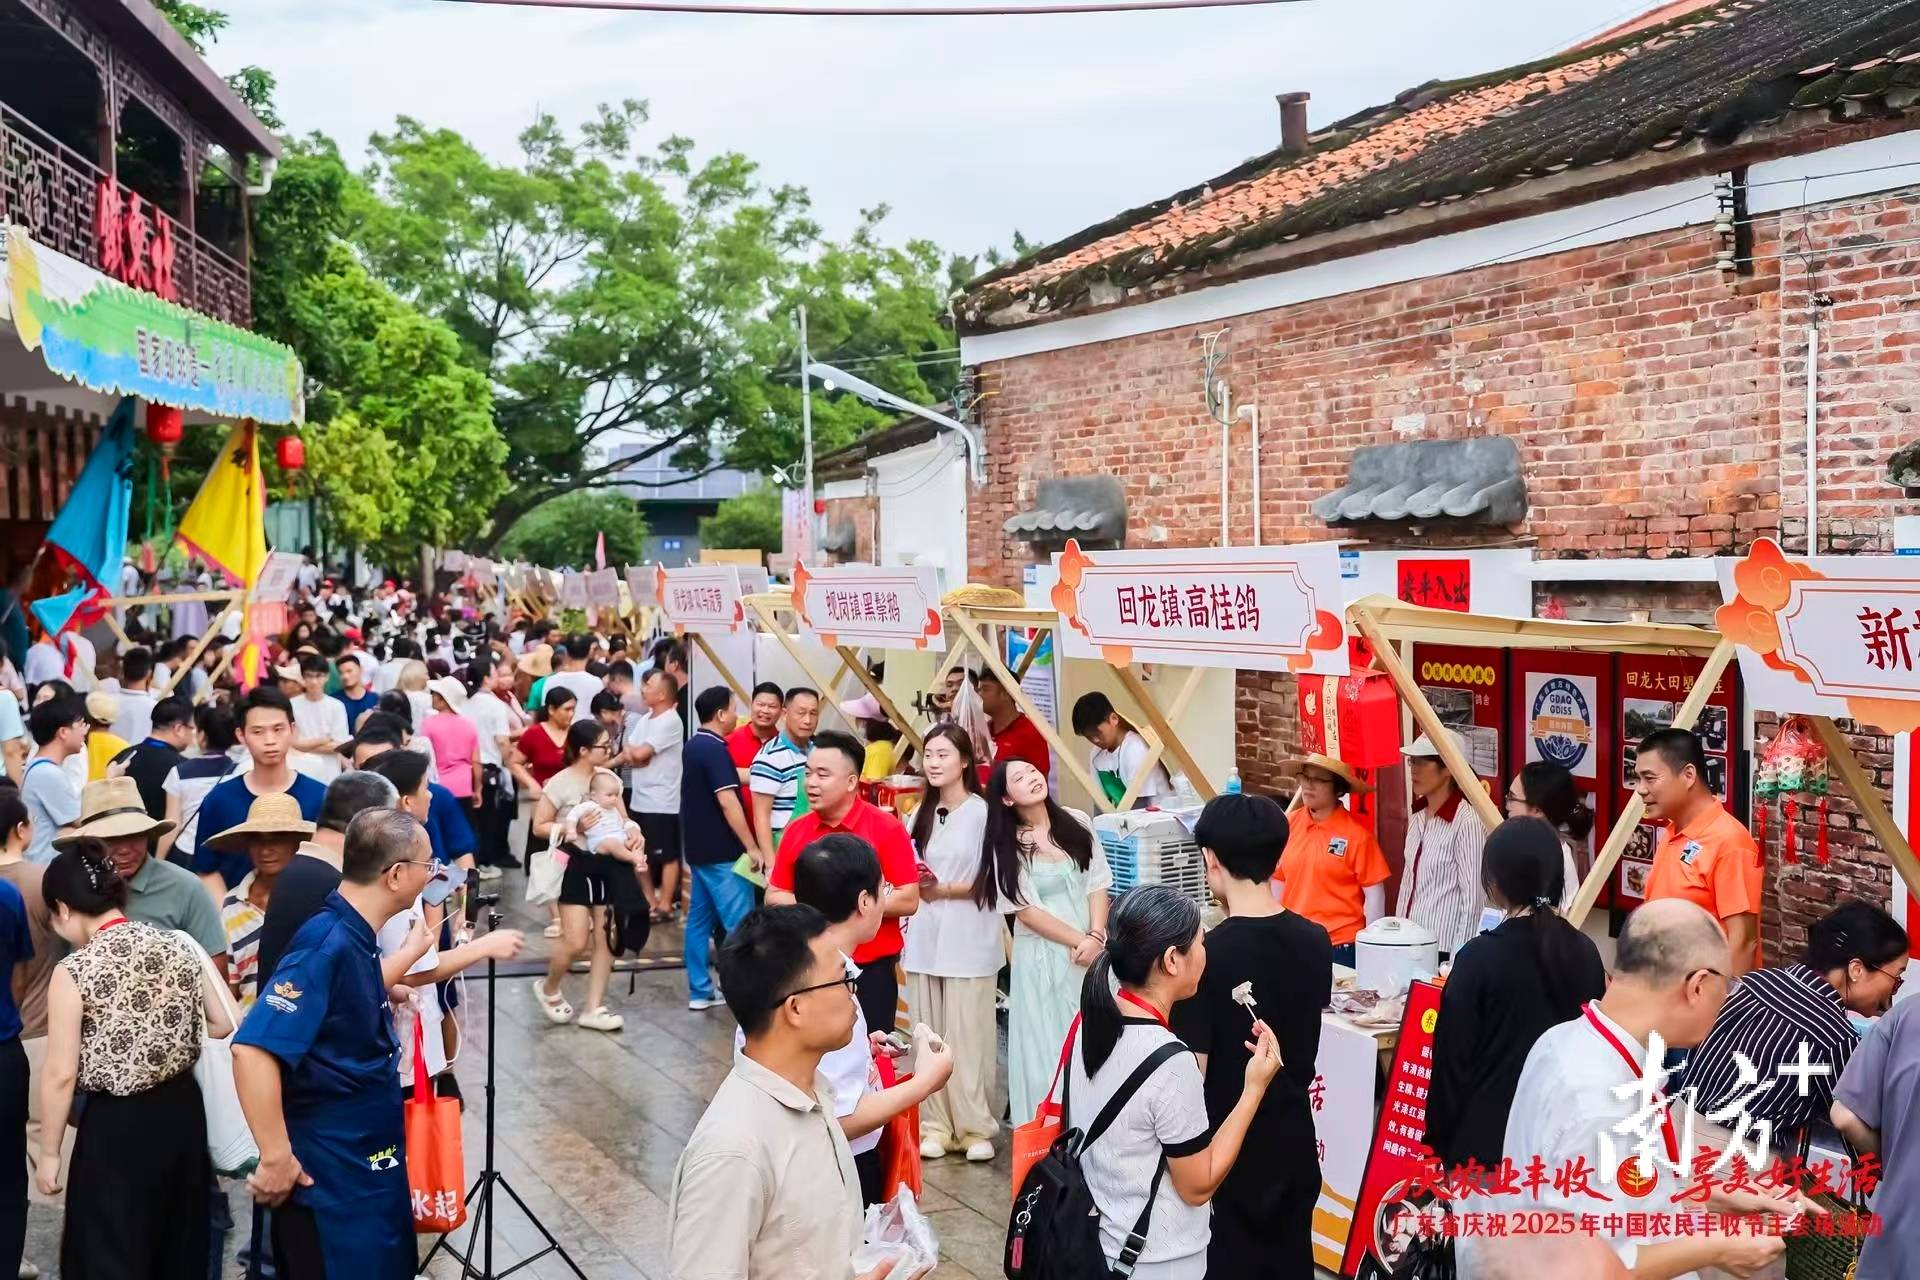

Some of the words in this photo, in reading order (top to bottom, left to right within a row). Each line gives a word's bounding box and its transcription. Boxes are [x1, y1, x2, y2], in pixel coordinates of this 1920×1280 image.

[1116, 583, 1260, 632] 回龙镇·高桂鸽
[1856, 606, 1920, 672] 新
[1549, 694, 1572, 705] GDAQ
[1549, 705, 1572, 715] GDISS
